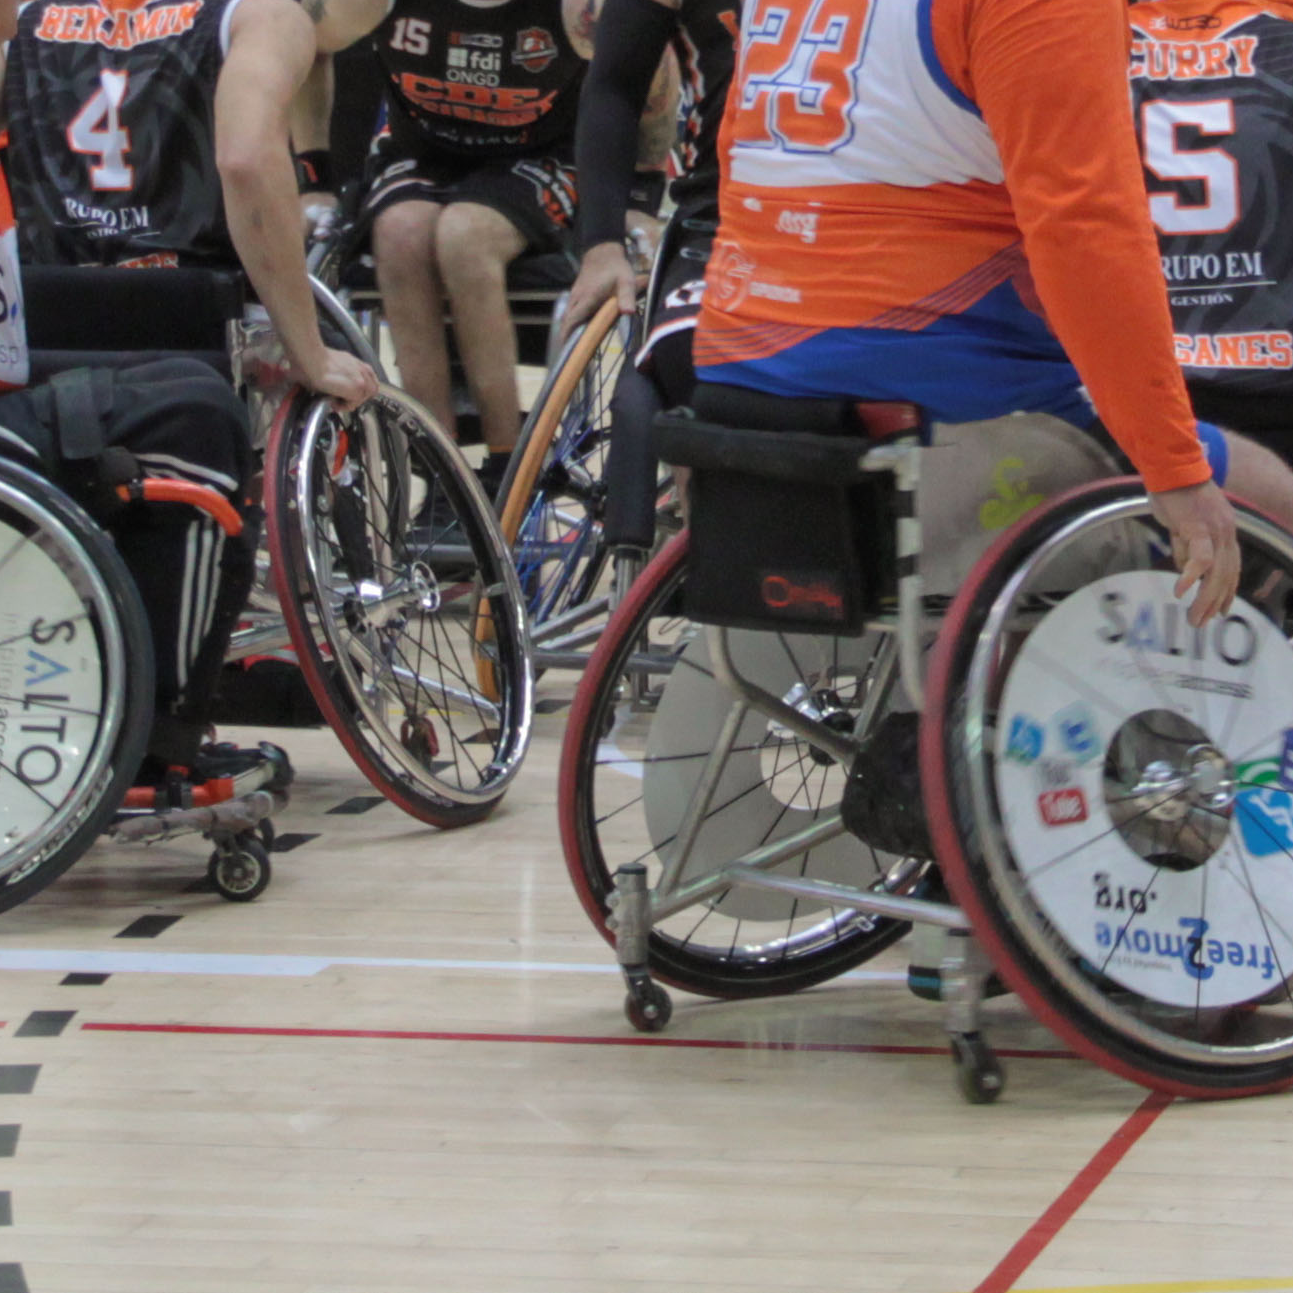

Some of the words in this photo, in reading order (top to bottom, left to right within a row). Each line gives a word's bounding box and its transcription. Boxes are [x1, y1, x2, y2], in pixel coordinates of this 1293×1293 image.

[389, 17, 433, 56] 15
[445, 68, 500, 88] ONGD
[470, 50, 502, 71] fdi
[400, 72, 541, 112] CDE
[66, 67, 136, 192] 4
[1140, 98, 1241, 235] 5
[63, 196, 119, 228] RUPO
[120, 205, 150, 231] EM
[1160, 253, 1221, 281] RUPO
[1225, 251, 1264, 278] EM
[1170, 291, 1234, 307] GESTIÓN
[16, 616, 77, 787] SALTO
[1094, 873, 1157, 914] .org
[1094, 915, 1276, 981] free2move
